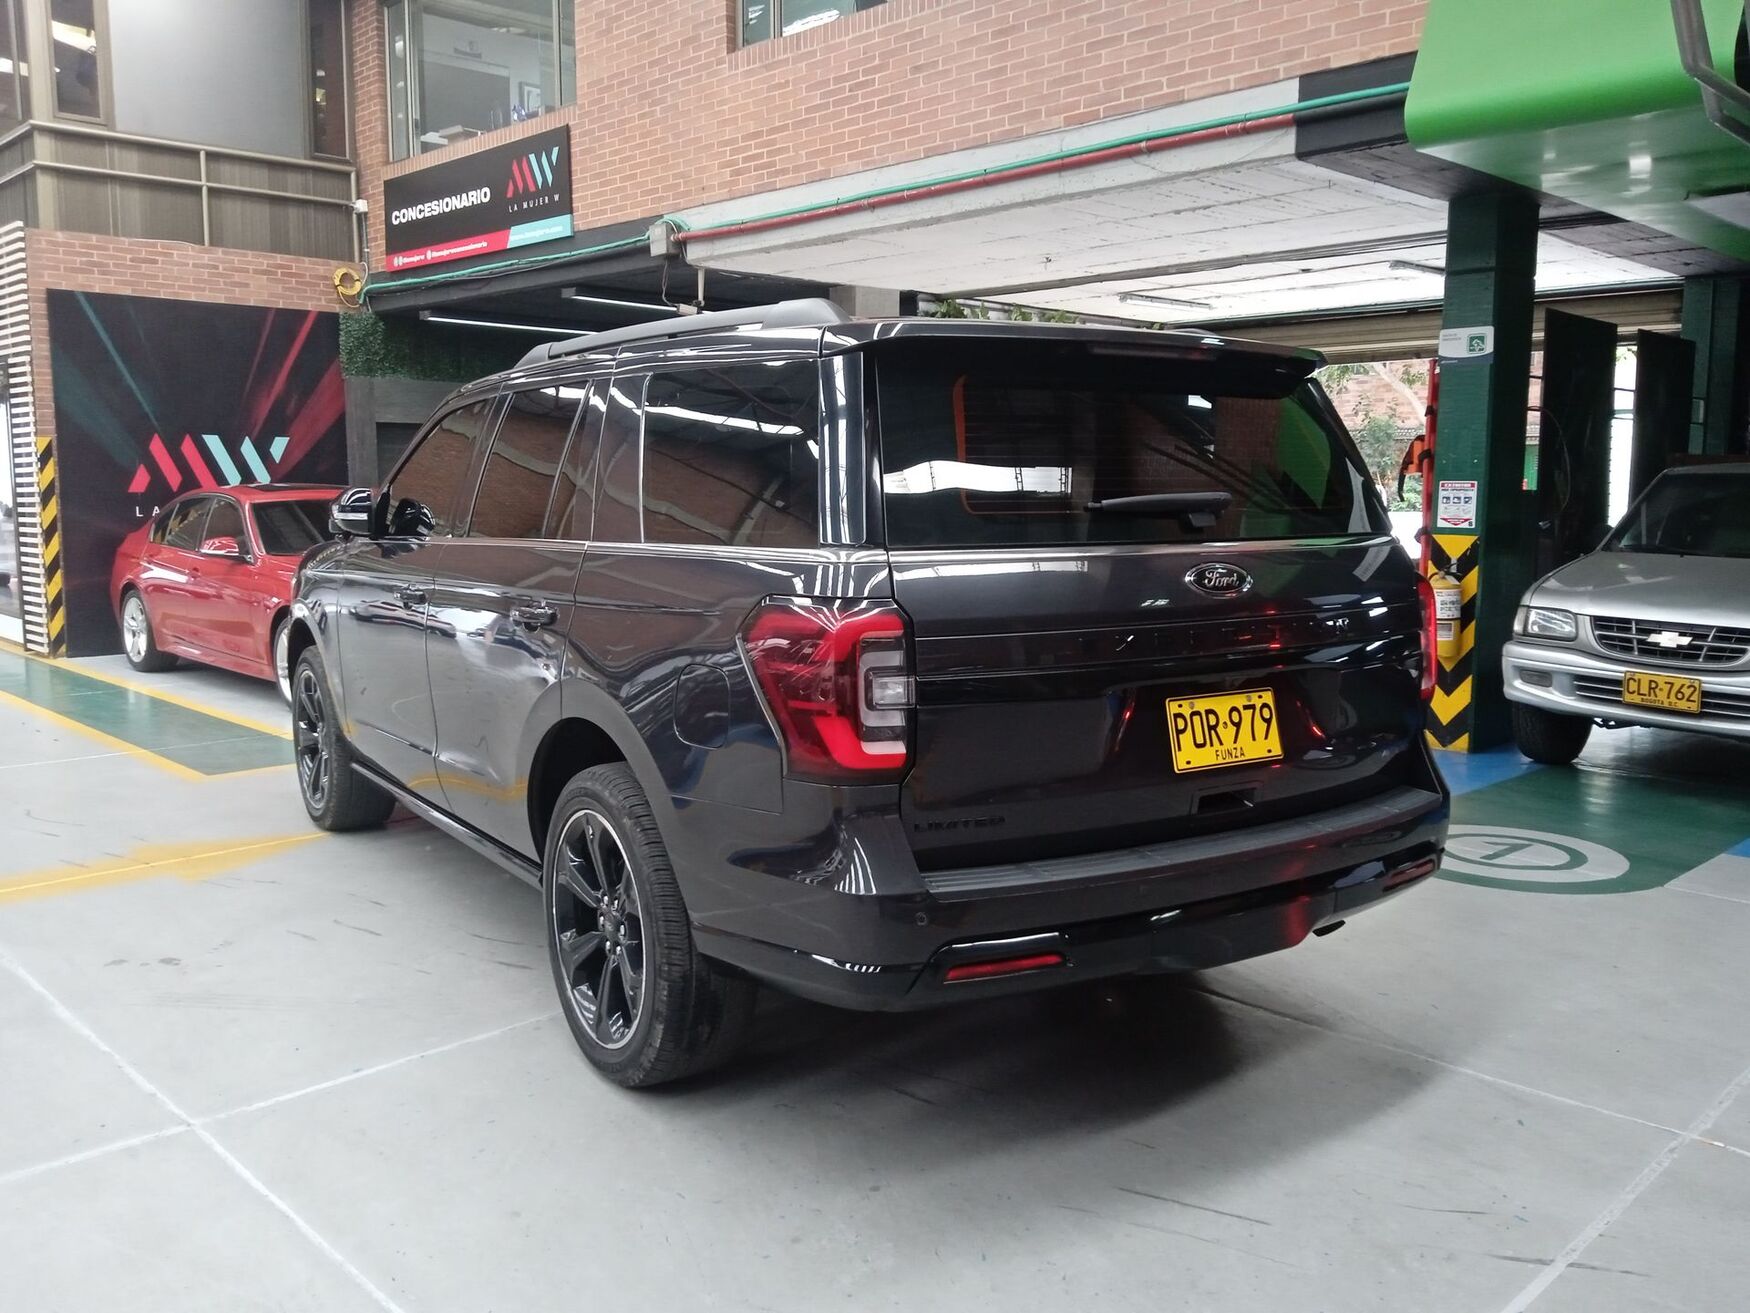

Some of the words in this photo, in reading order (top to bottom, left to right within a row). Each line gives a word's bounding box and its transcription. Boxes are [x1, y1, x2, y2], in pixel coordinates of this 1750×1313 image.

[391, 186, 491, 226] CONCESIONARIO
[508, 203, 518, 213] LA
[522, 195, 549, 209] MUJER
[553, 193, 560, 202] W
[1203, 568, 1240, 588] Ford
[1215, 746, 1246, 761] FUNZA
